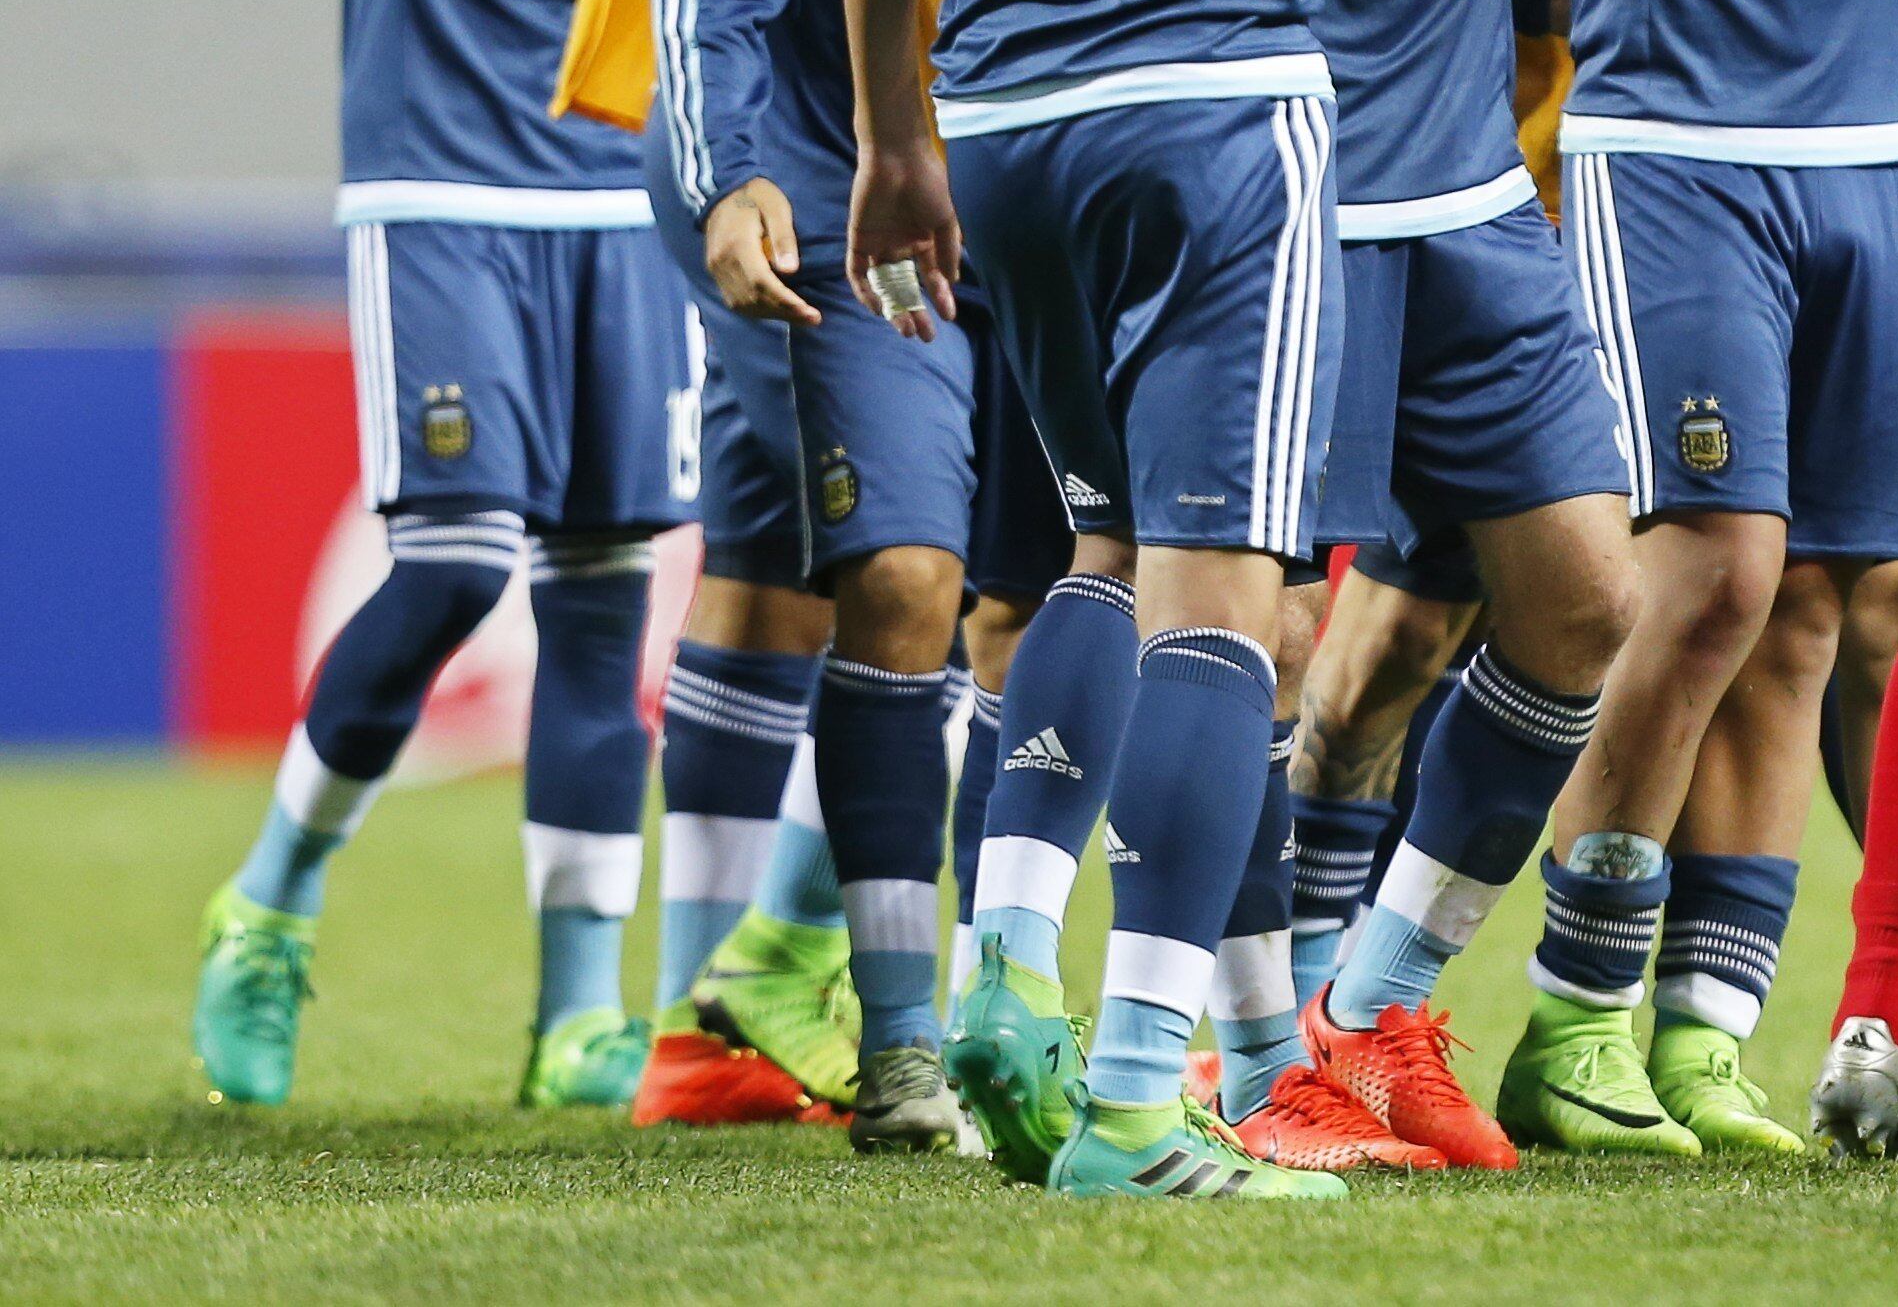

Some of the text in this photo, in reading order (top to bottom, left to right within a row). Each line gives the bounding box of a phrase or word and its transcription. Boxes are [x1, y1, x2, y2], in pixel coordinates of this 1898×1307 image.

[665, 387, 703, 503] 19
[1178, 492, 1226, 505] climacool
[1003, 753, 1083, 780] adidas
